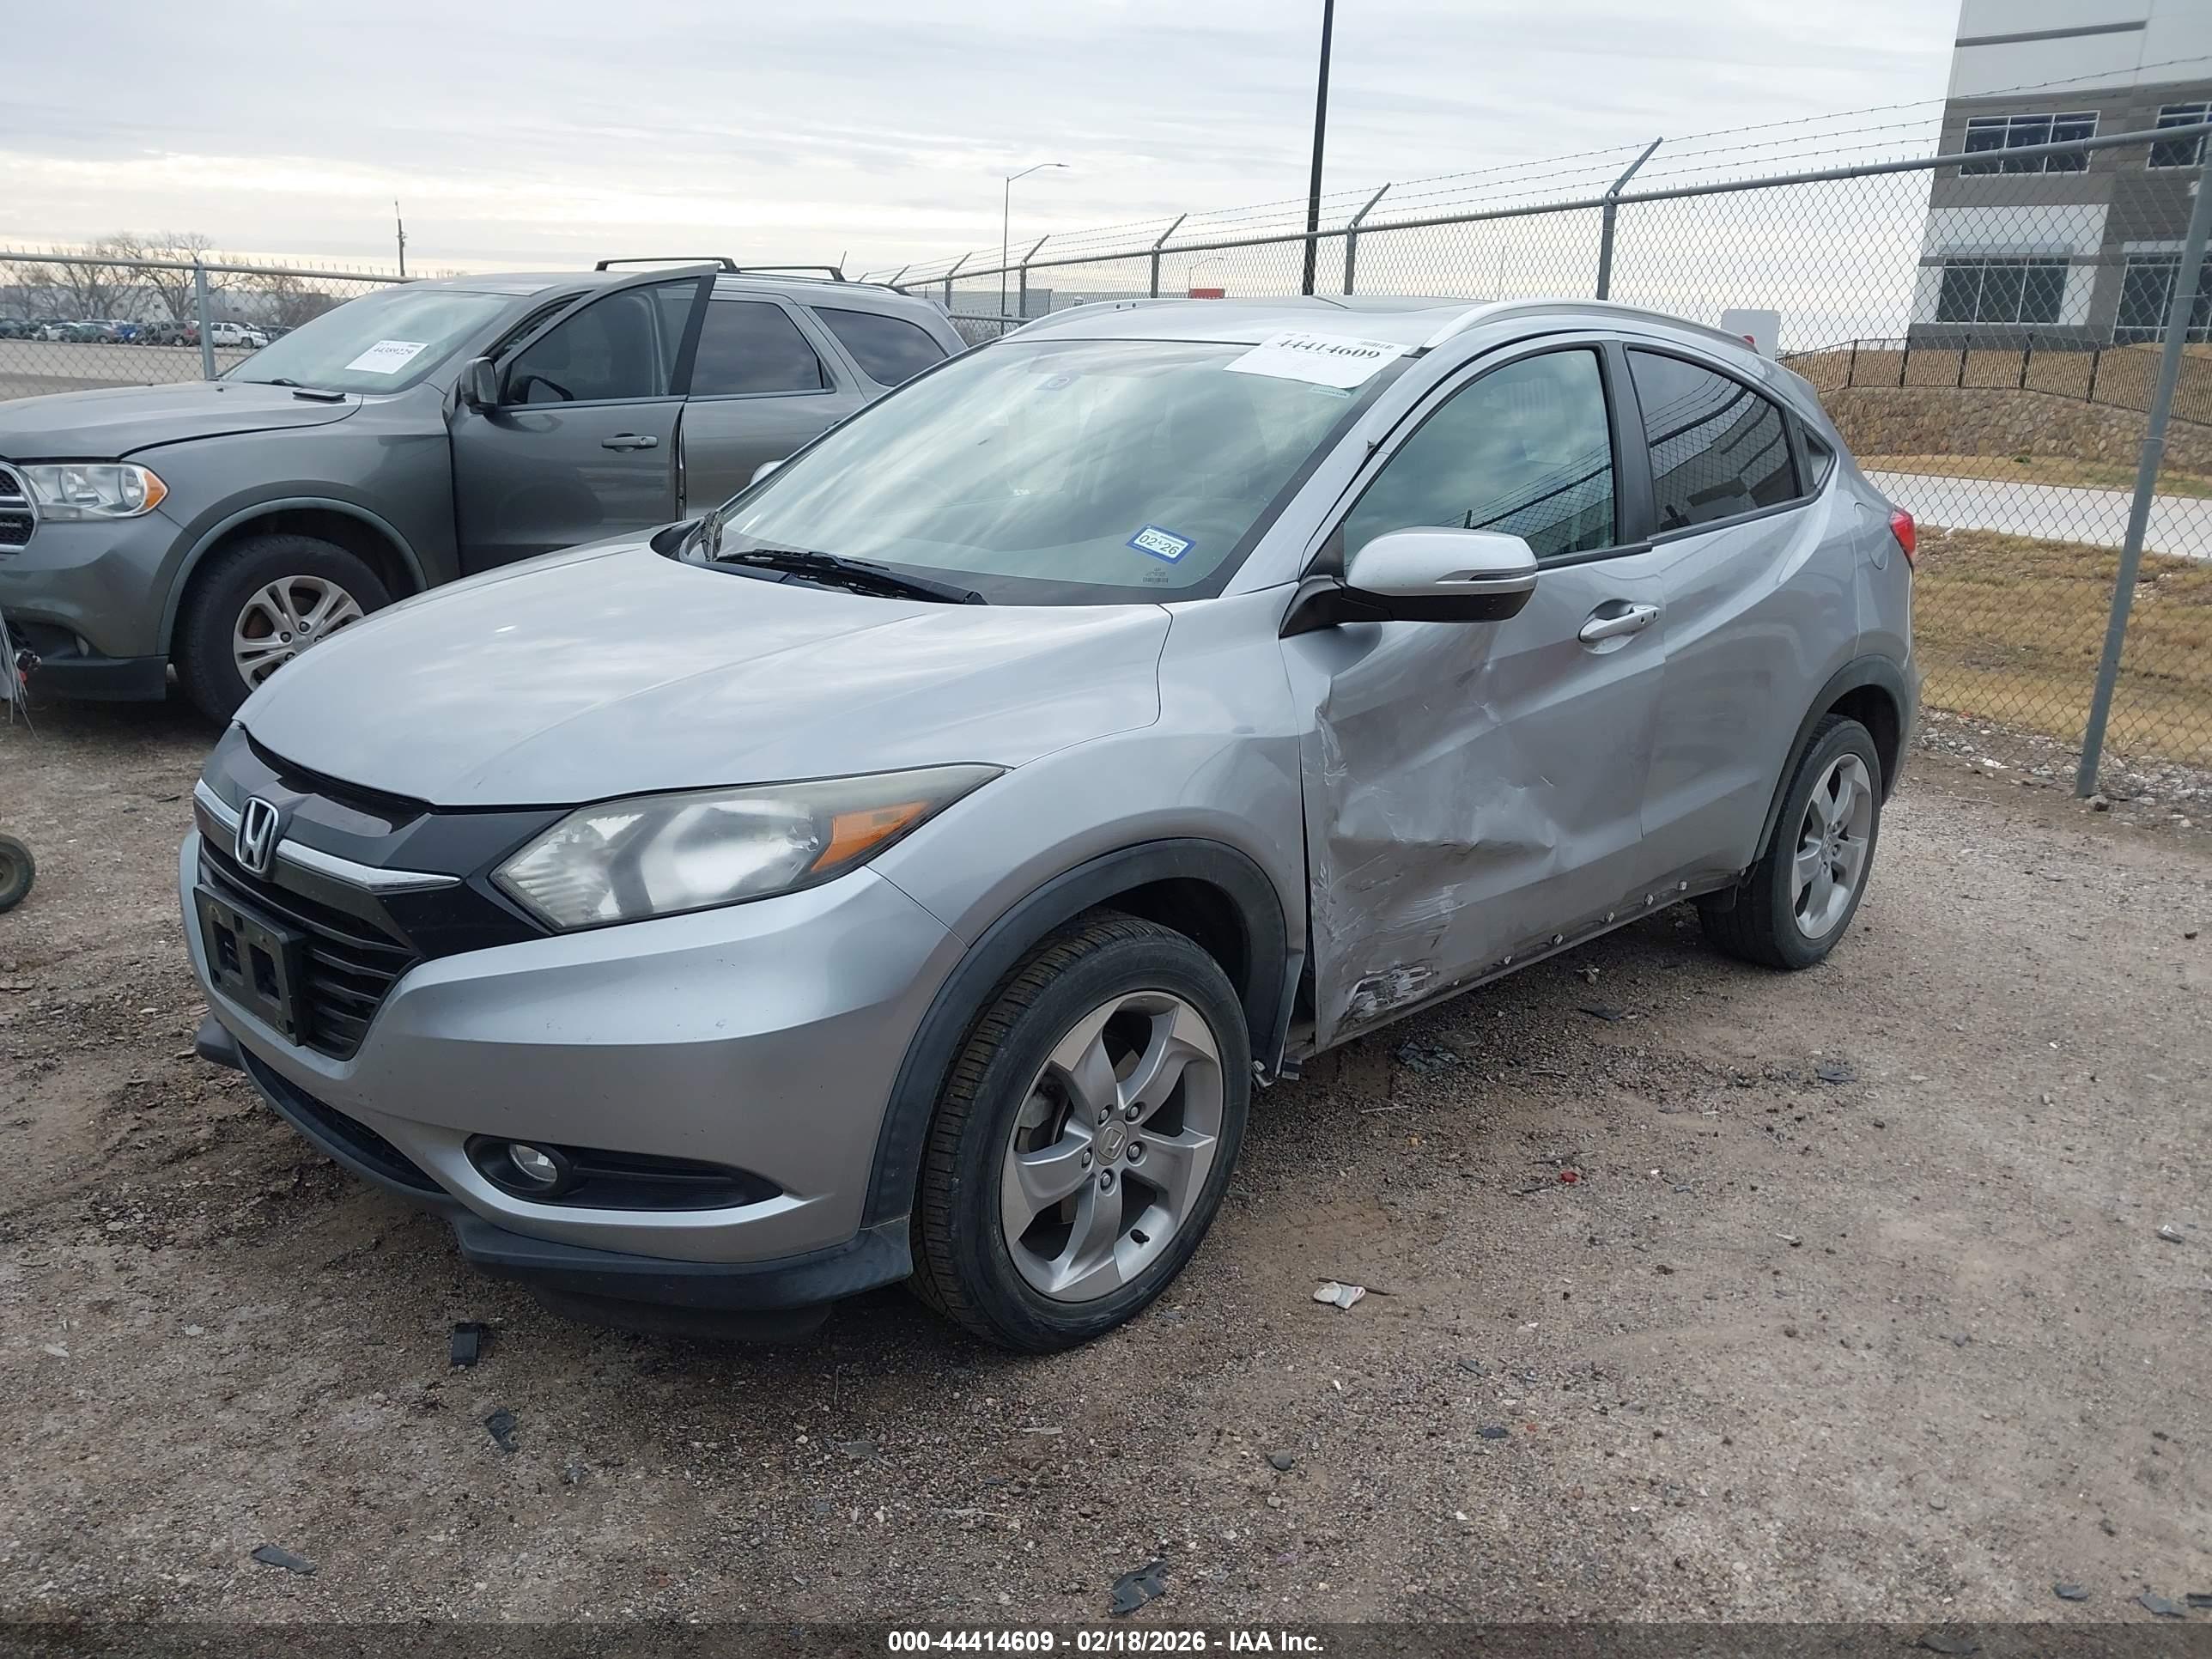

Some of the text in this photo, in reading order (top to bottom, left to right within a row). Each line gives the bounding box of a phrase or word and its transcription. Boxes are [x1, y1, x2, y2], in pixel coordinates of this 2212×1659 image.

[1277, 339, 1381, 359] 44414609
[1139, 534, 1158, 546] 02
[1159, 543, 1180, 555] 26
